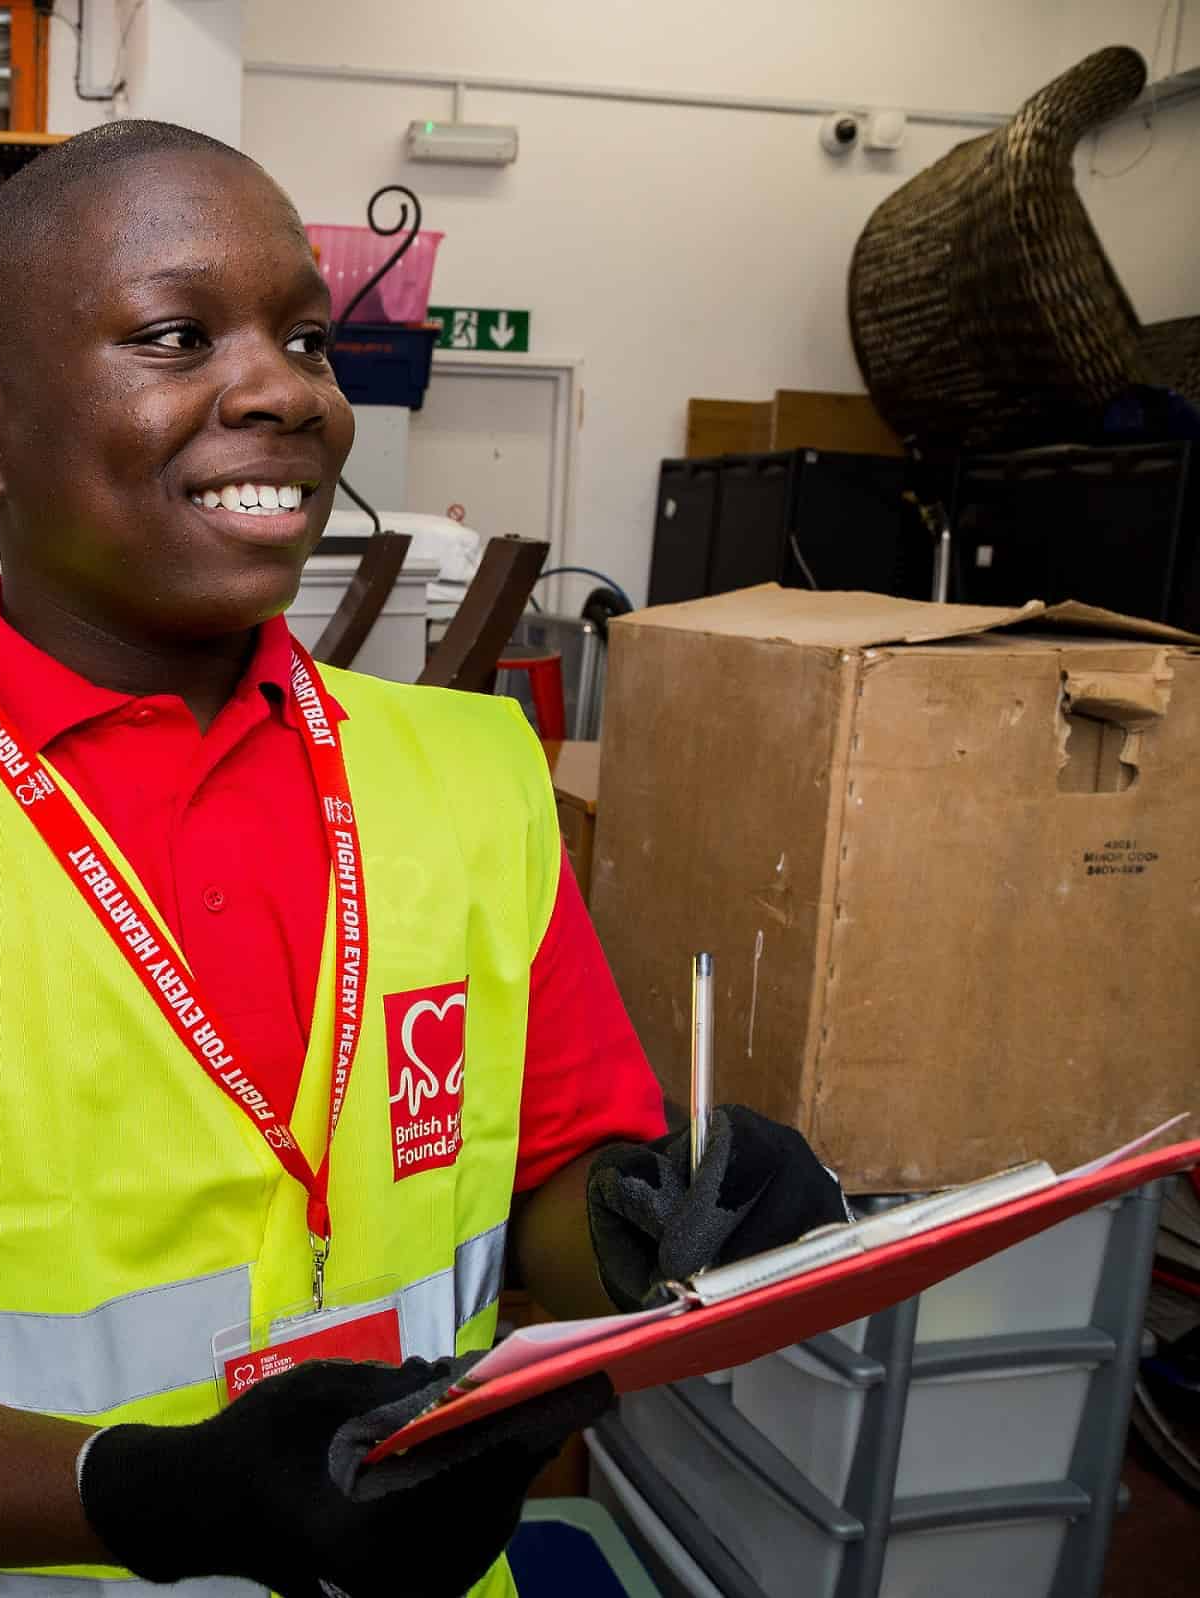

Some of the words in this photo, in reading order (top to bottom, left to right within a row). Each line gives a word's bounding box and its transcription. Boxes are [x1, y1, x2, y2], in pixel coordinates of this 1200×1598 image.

[291, 663, 336, 747] HEARTBEAT
[335, 831, 357, 895] FIGHT
[68, 846, 161, 962] HEARTBEAT
[341, 900, 360, 942] FOR
[146, 960, 205, 1029] EVERY
[341, 946, 361, 1019] EVERY
[192, 1024, 233, 1070] FOR
[219, 1068, 275, 1121] FIGHT
[395, 1115, 442, 1146] British
